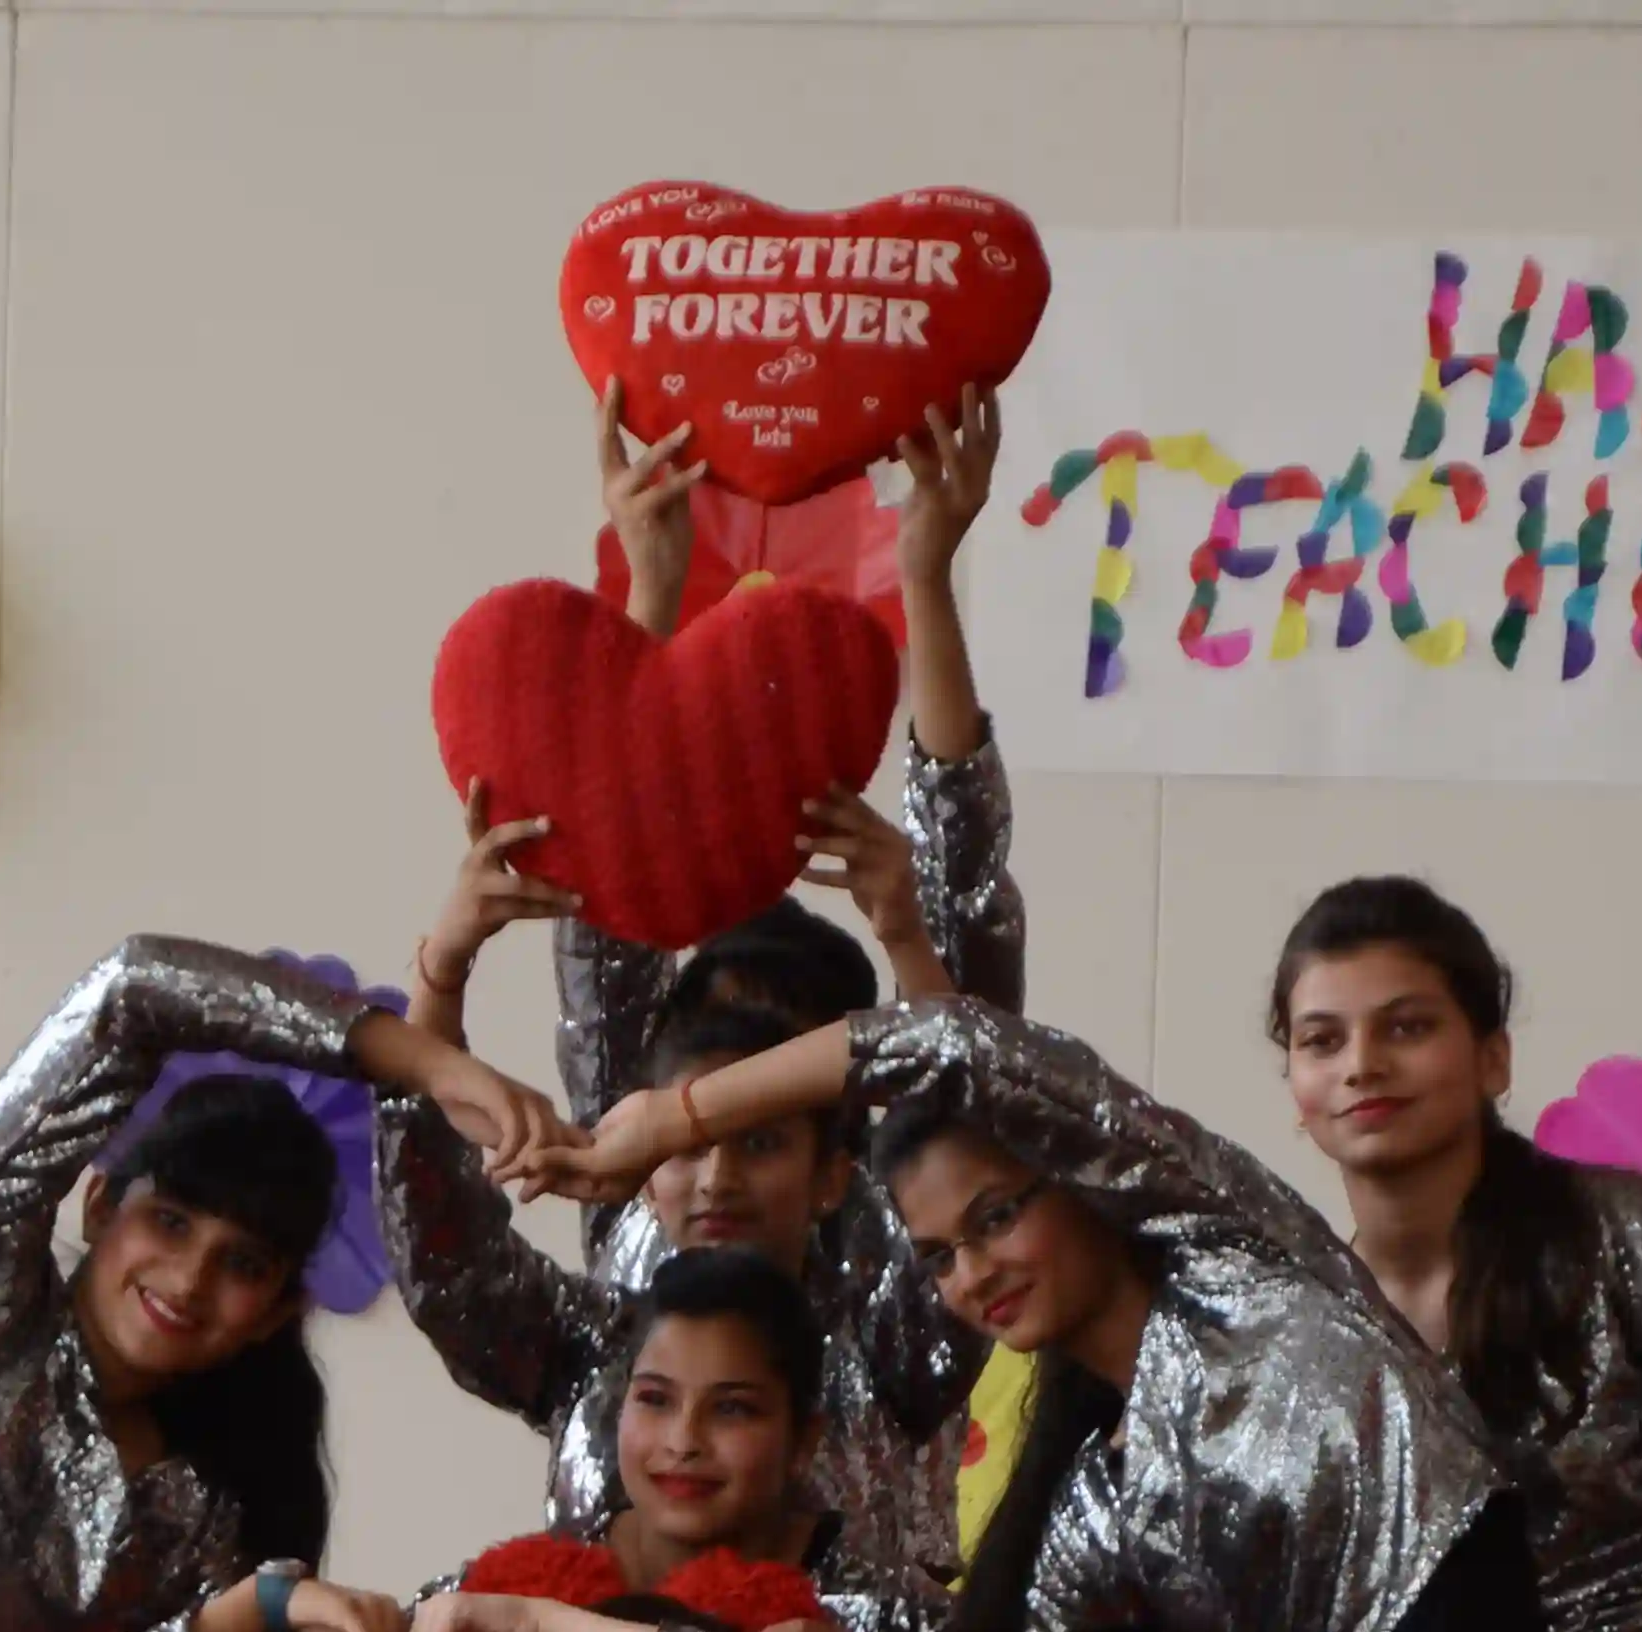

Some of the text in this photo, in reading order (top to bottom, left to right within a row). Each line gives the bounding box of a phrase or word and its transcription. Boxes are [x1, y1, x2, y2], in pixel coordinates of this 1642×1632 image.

[587, 197, 644, 235] LOVE
[649, 187, 698, 207] YOU
[621, 235, 961, 286] TOGETHER
[632, 293, 930, 346] FOREVER
[722, 400, 819, 425] Love you
